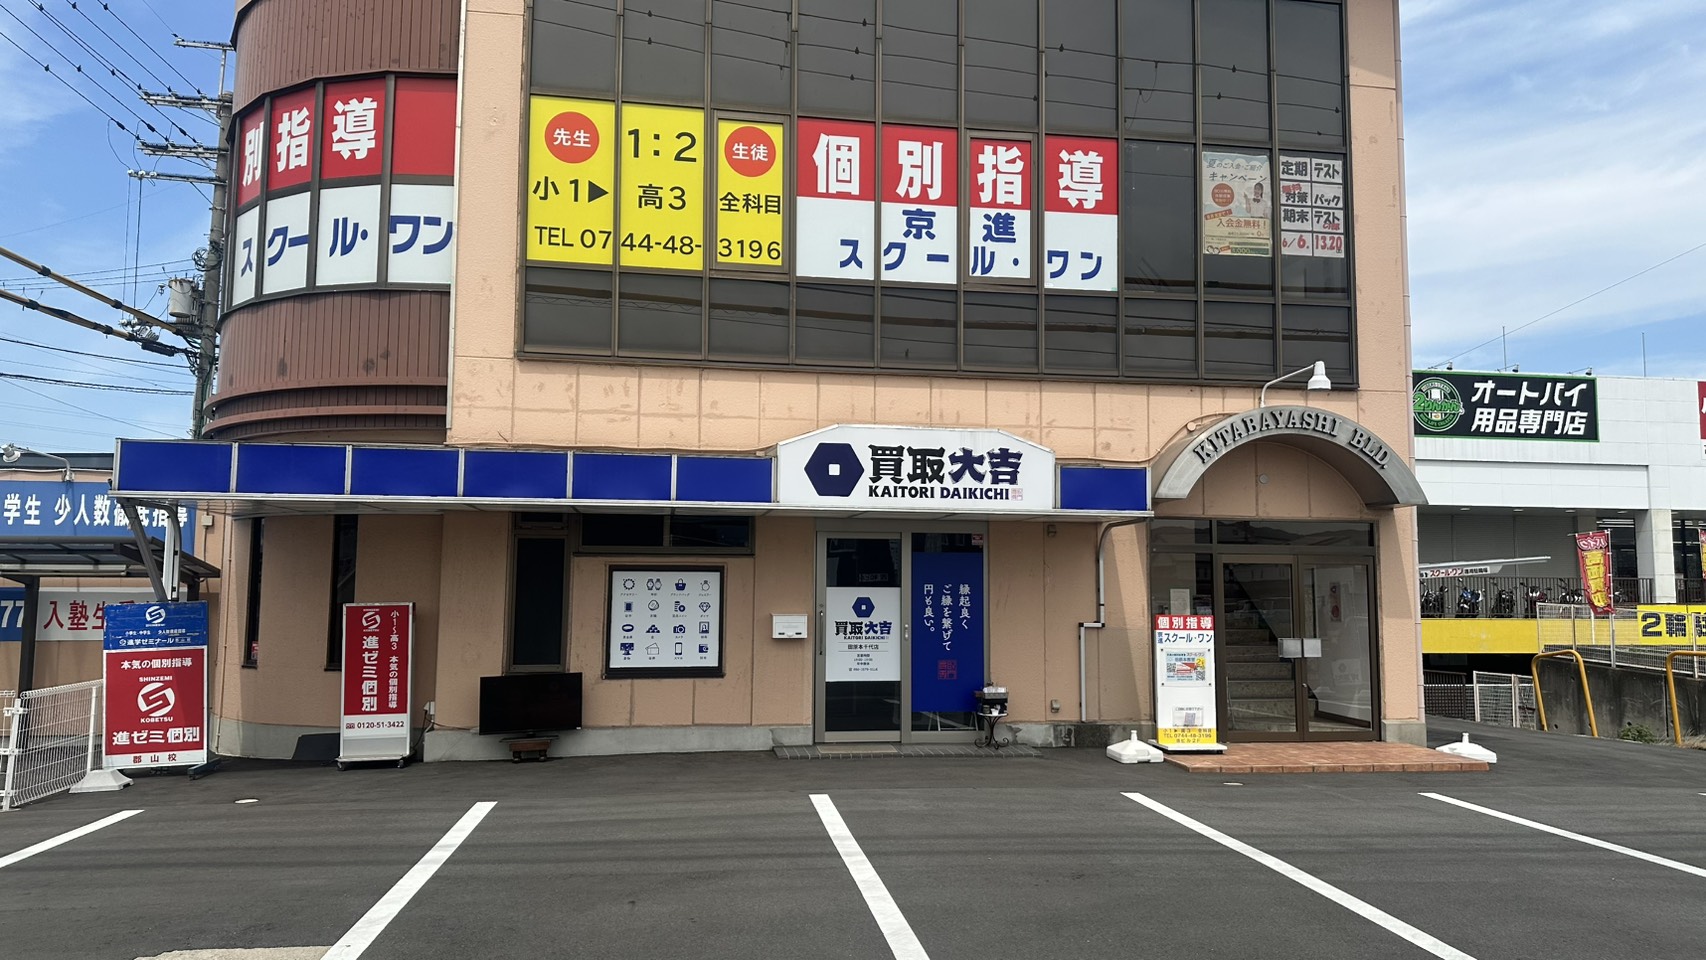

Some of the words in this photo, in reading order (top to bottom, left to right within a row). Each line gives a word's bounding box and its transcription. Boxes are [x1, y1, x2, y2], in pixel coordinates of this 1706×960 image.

[553, 127, 592, 148] 先生
[732, 142, 769, 162] 生徒
[812, 132, 1104, 210] 個別指導
[1209, 171, 1267, 183] キャンペーン
[1281, 160, 1308, 177] 定期
[1314, 162, 1340, 180] テスト
[719, 191, 782, 215] 全科目
[1285, 191, 1308, 204] 対策
[1314, 193, 1340, 207] パック
[902, 207, 1017, 244] 京進
[1282, 208, 1309, 224] 期末
[1314, 210, 1340, 225] テスト
[534, 225, 574, 247] TEL
[580, 228, 781, 261] 0744-48-3196
[839, 238, 1102, 281] スクール・ワン
[1471, 380, 1587, 407] オートバイ
[1471, 408, 1588, 436] 用品専門店
[1193, 409, 1343, 464] KITABAYASHI
[1350, 427, 1392, 468] BLD.
[868, 444, 1023, 485] 買取大吉
[868, 485, 935, 499] KAITORI
[940, 487, 1010, 500] DAIKICHI
[3, 493, 41, 525] 学生
[924, 584, 936, 632] 円も良い。
[940, 583, 954, 651] ご縁を繋げて
[959, 583, 971, 630] 縁起良く
[834, 620, 892, 636] 買取大吉
[1158, 616, 1213, 629] 個別指導
[1164, 632, 1213, 643] スクール・ワン
[120, 657, 193, 670] 本気の個別指導
[361, 635, 379, 712] 進ゼミ個別
[138, 675, 173, 683] SHINZEMI
[140, 716, 173, 724] KOBETSU
[356, 719, 405, 730] 0120-51-3422
[112, 726, 200, 746] 進ゼミ個別
[132, 752, 177, 764] 郡山校
